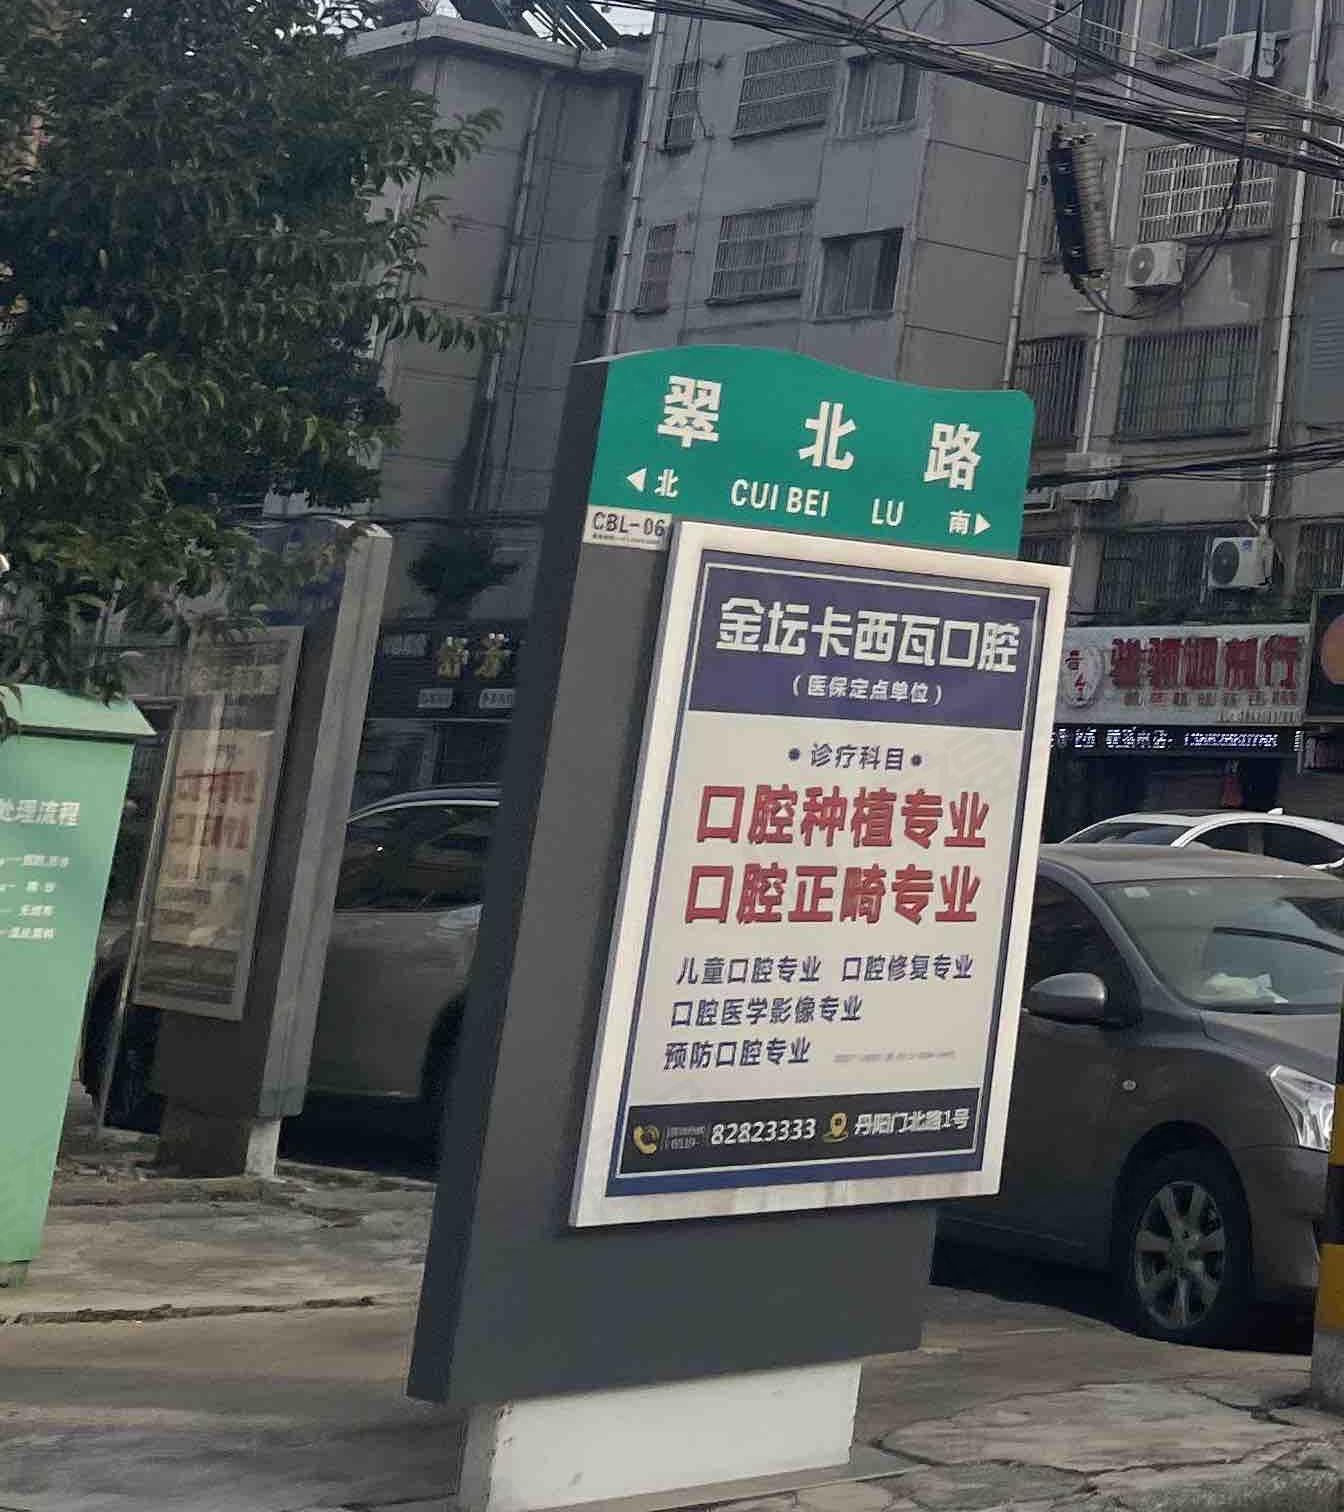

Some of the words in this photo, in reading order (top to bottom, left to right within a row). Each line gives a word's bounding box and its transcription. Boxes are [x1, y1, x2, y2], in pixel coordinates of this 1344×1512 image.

[657, 375, 983, 491] 翠北路
[654, 468, 680, 498] 北
[730, 478, 779, 511] CUI
[785, 486, 830, 518] BEI
[871, 497, 905, 527] LU
[592, 510, 665, 538] CBL-06
[949, 511, 972, 537] 南
[716, 597, 1021, 674] 金坛卡西瓦口腔
[809, 743, 906, 772] 诊疗科目
[695, 783, 991, 850] 口腔种植专业
[683, 862, 983, 926] 口腔正畸专业
[675, 954, 822, 986] 儿童口腔专业
[840, 953, 975, 983] 口腔修复专业
[670, 994, 864, 1029] 口腔医学影像专业
[663, 1036, 812, 1072] 预防口腔专业
[710, 1117, 817, 1147] 82823333
